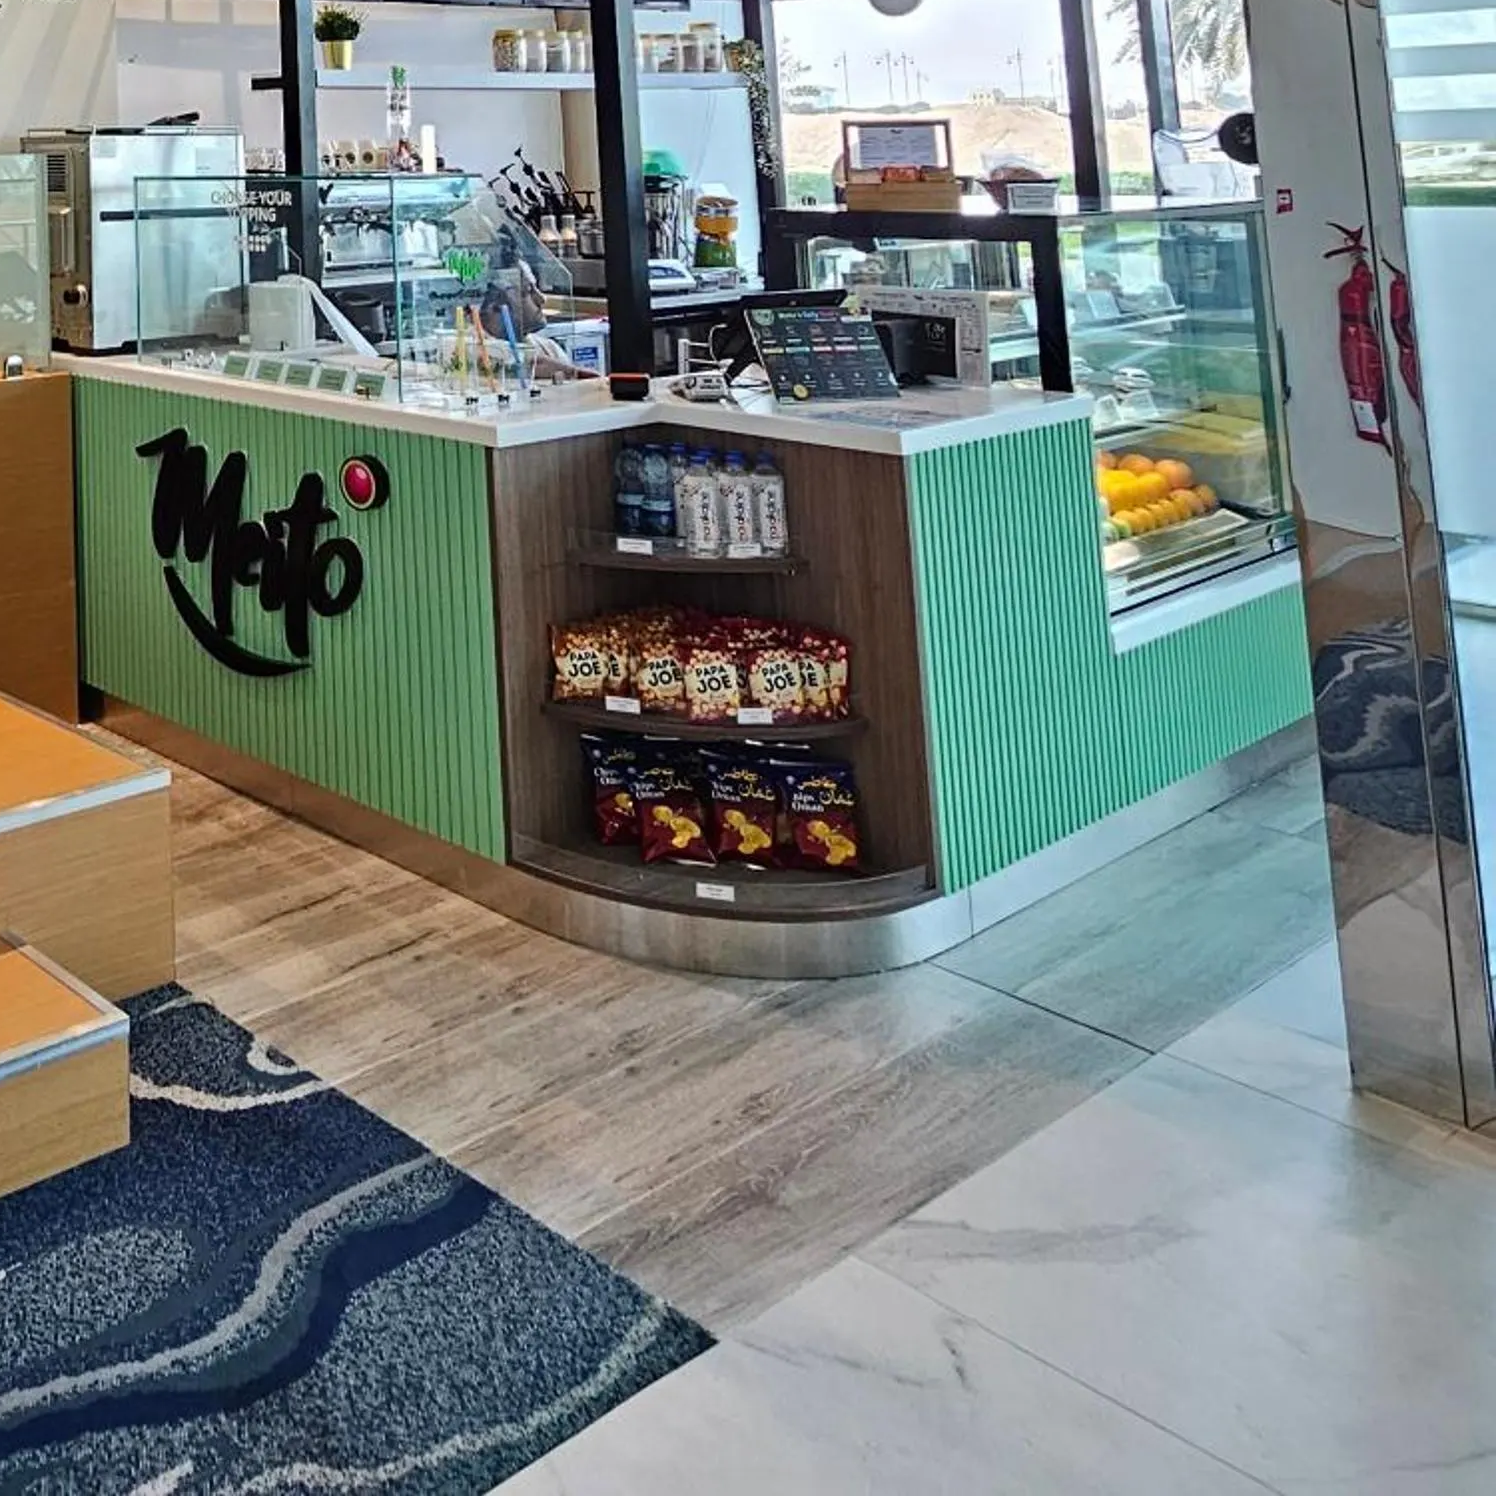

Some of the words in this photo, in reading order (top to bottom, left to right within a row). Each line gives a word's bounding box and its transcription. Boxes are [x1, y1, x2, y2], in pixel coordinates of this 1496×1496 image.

[260, 190, 292, 206] YOUR
[569, 650, 598, 662] PAPA
[568, 661, 603, 677] JOE
[650, 658, 678, 671] PAPA
[695, 664, 728, 678] PAPA
[761, 662, 790, 676] PAPA
[648, 669, 685, 687] JOE
[696, 676, 733, 694] JOE
[763, 672, 798, 694] JOE
